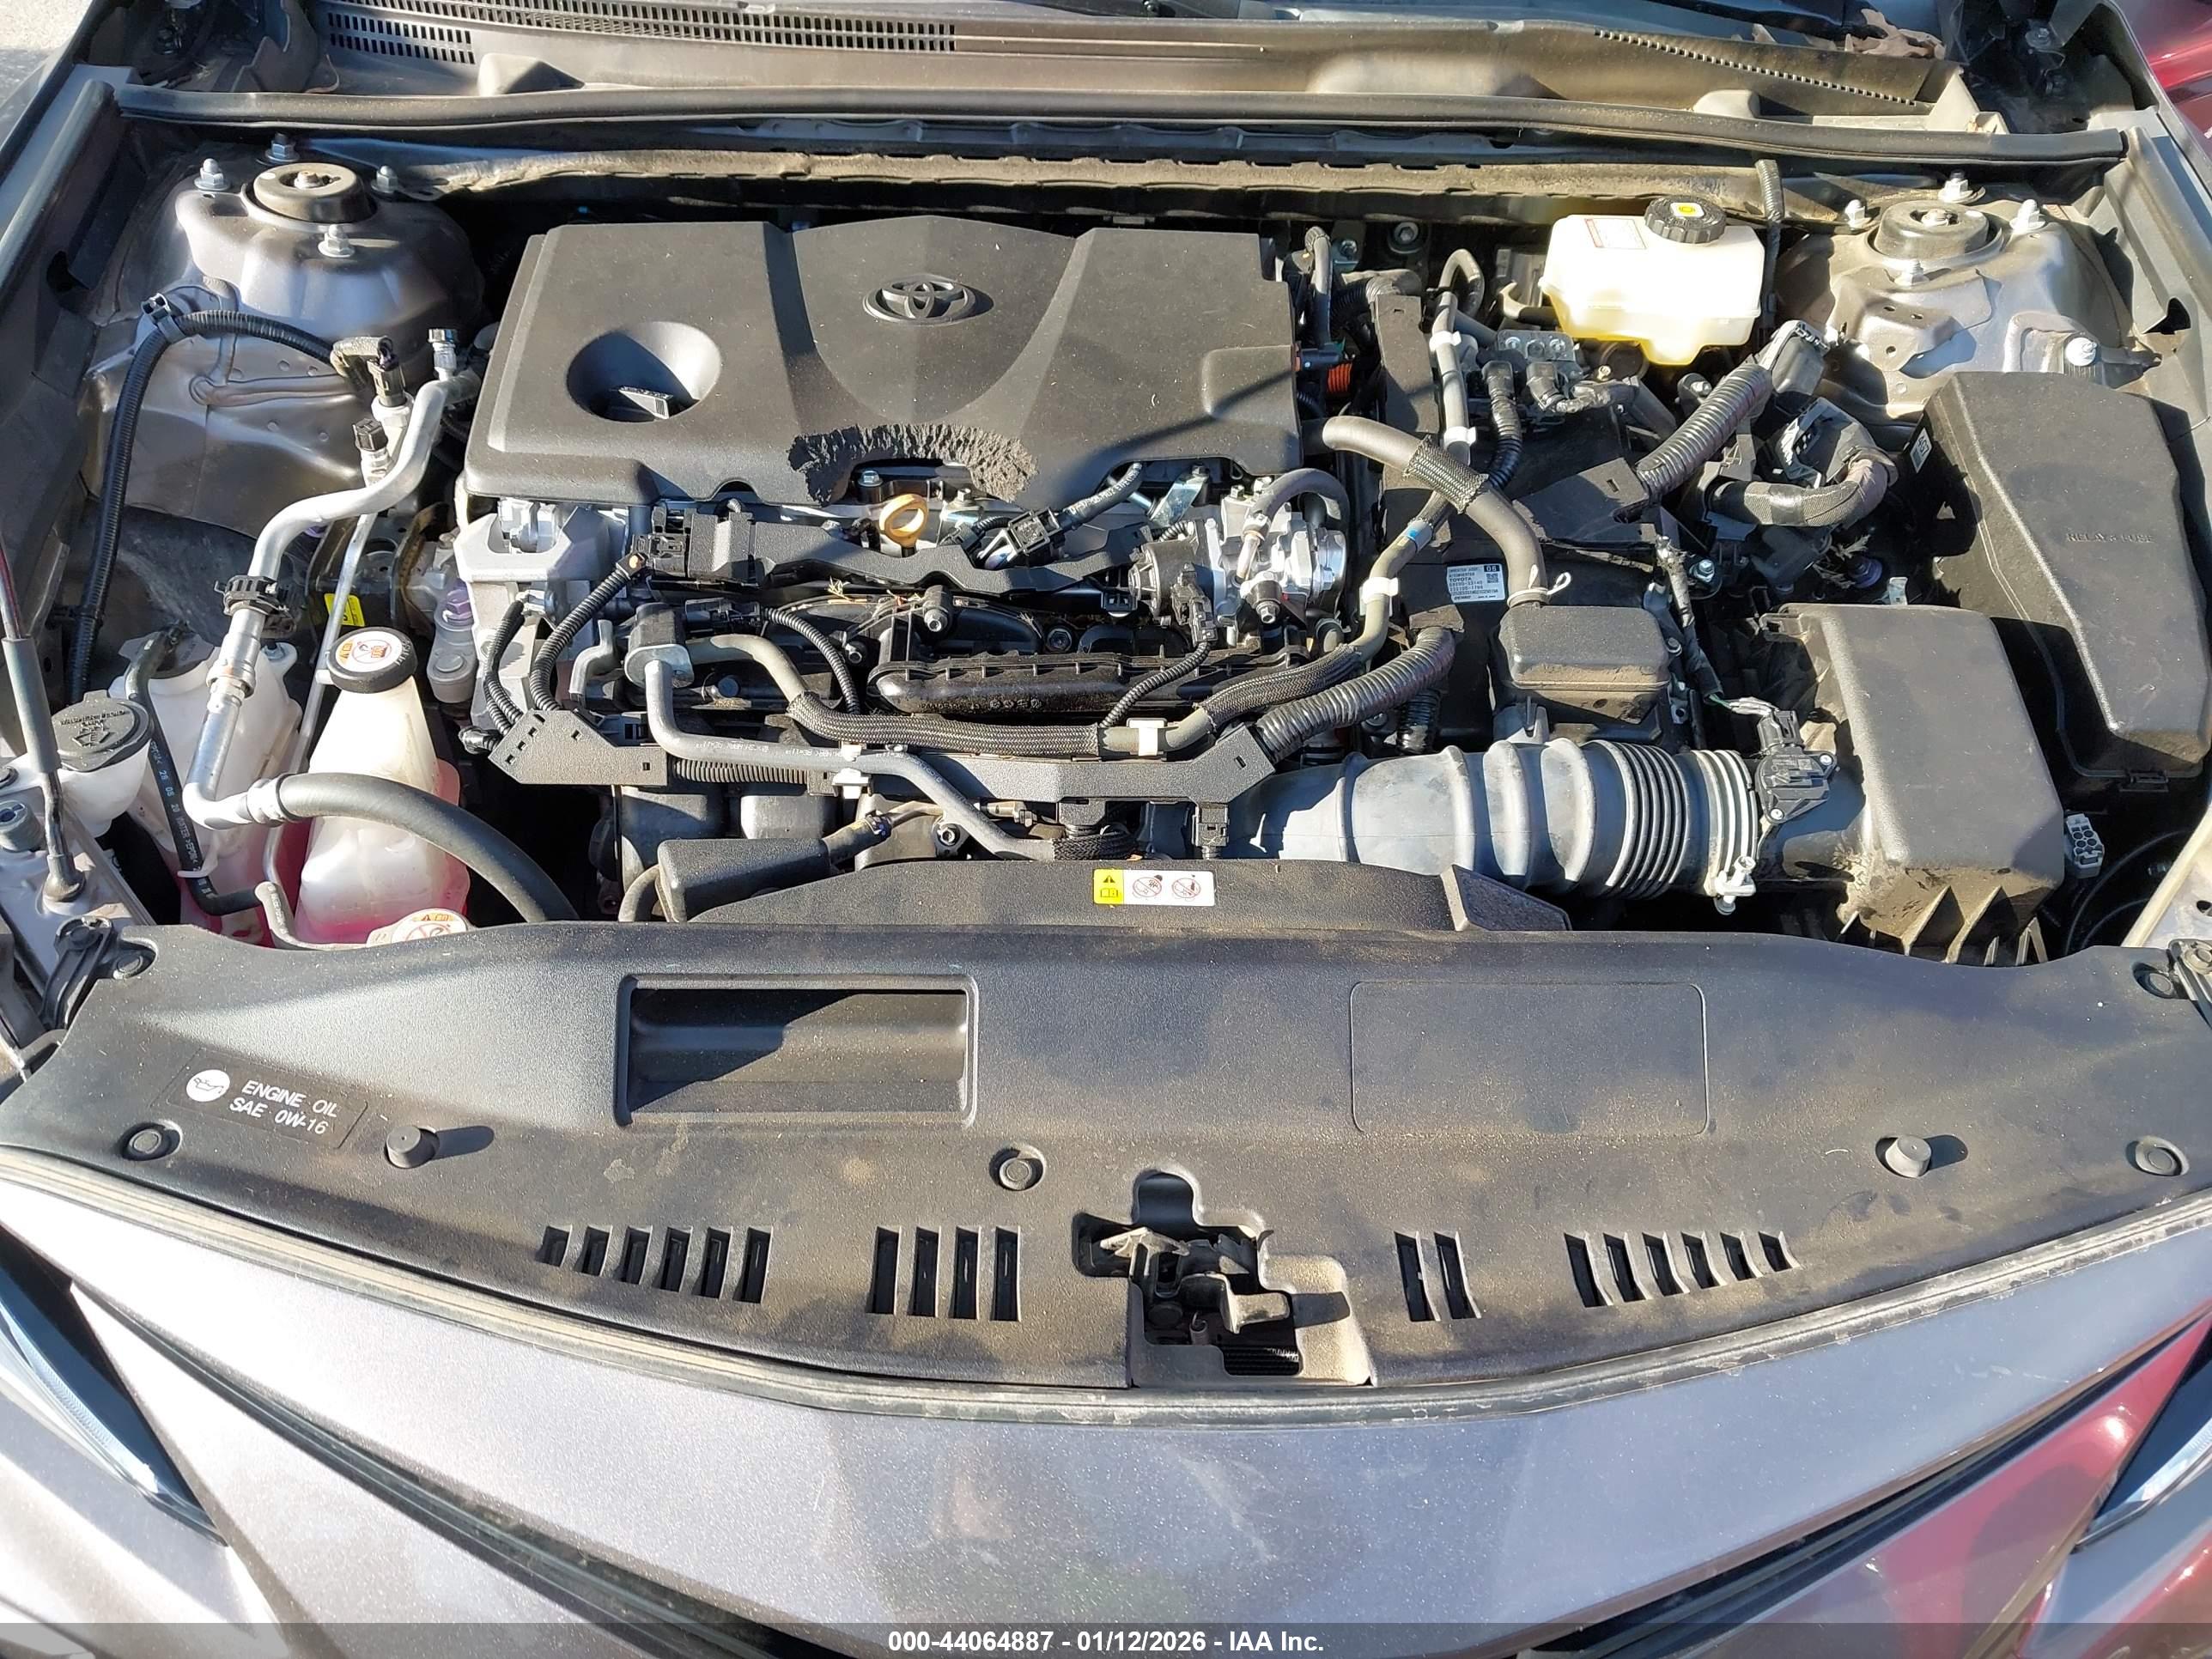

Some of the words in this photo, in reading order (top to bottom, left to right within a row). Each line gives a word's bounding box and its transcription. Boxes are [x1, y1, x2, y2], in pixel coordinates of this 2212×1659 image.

[1917, 436, 1929, 457] 4G7
[171, 803, 180, 813] 20
[241, 1079, 307, 1108] ENGINE
[312, 1099, 338, 1117] OIL
[229, 1097, 269, 1118] SAE
[274, 1109, 329, 1134] 0W-16
